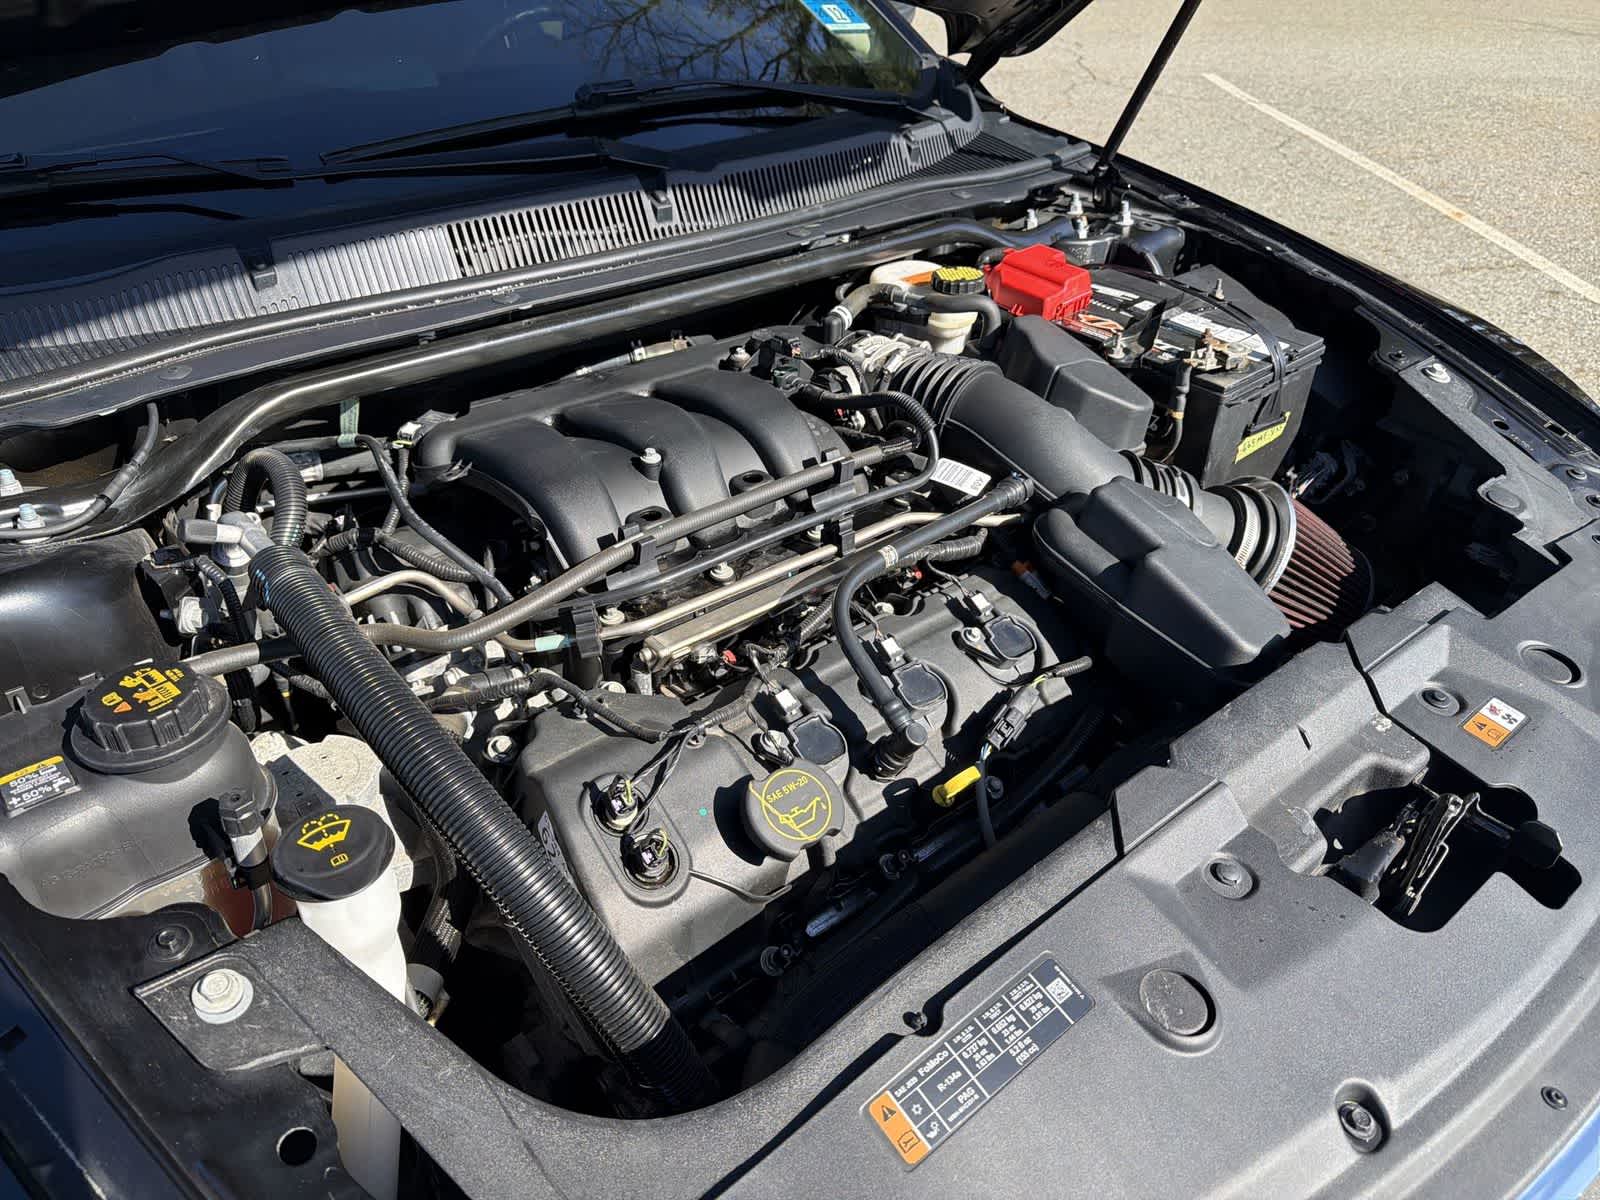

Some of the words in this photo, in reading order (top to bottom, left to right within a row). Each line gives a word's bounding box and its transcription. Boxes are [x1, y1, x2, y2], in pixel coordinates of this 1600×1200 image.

[766, 789, 784, 803] SAE
[782, 775, 808, 795] 5W-20
[1032, 991, 1044, 1001] kg
[1035, 1001, 1044, 1009] oz
[1040, 1005, 1051, 1014] lbs
[1004, 1013, 1017, 1023] kg
[1001, 1028, 1010, 1038] 23
[1008, 1024, 1017, 1032] oz
[1013, 1028, 1024, 1038] lbs
[976, 1037, 989, 1047] kg
[1008, 1045, 1021, 1057] 5.2
[1023, 1036, 1033, 1046] oz
[979, 1048, 988, 1056] oz
[1027, 1042, 1040, 1055] cc)
[985, 1052, 996, 1062] lbs
[894, 1085, 908, 1098] SAE
[917, 1050, 949, 1077] FoMoCo
[936, 1070, 963, 1093] R-134a
[957, 1086, 976, 1104] PAG
